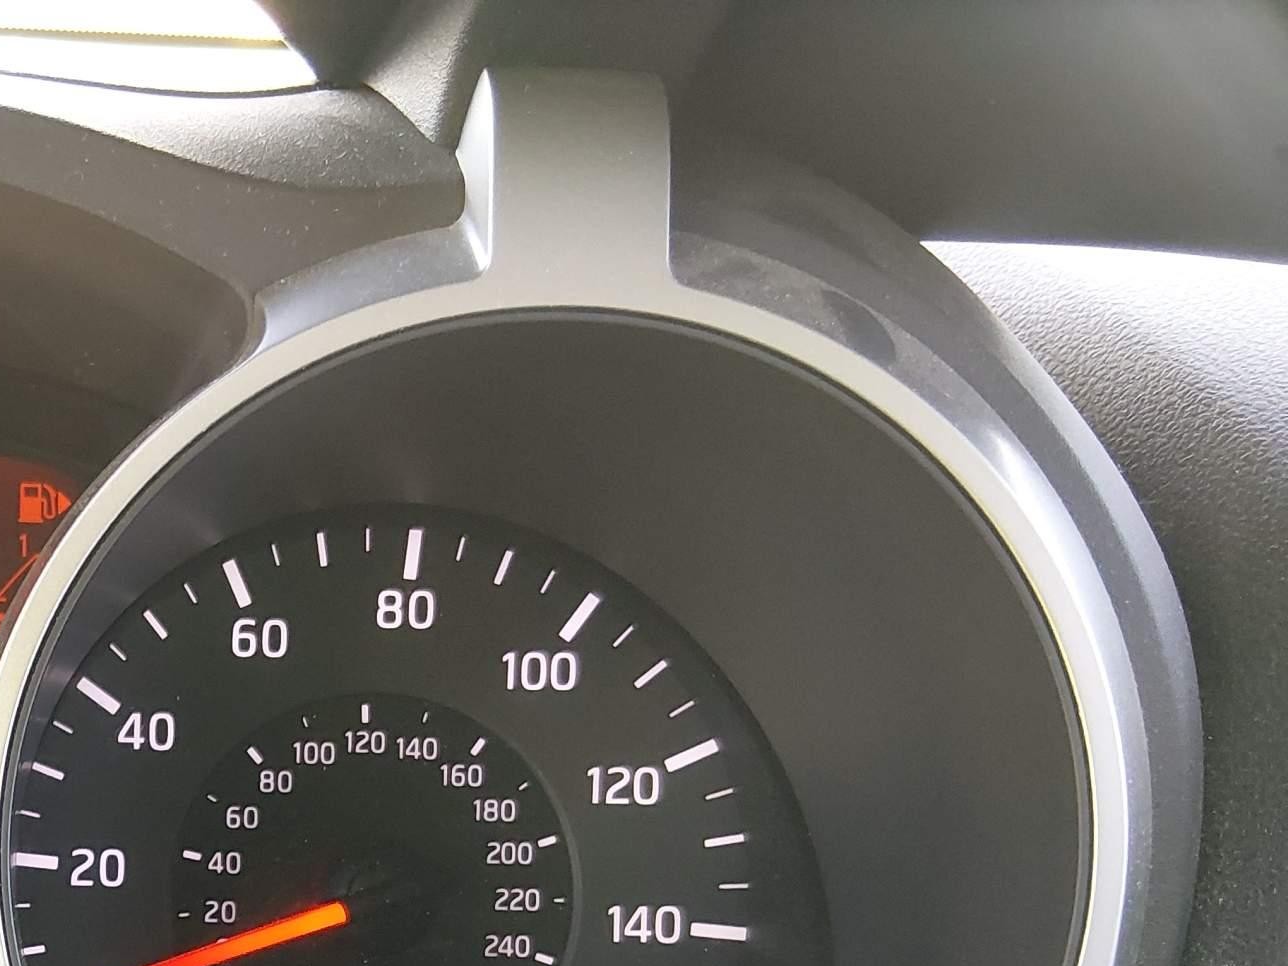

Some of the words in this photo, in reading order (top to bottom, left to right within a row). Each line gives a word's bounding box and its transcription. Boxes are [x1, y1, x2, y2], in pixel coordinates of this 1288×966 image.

[376, 590, 435, 629] 80
[231, 618, 289, 658] 60
[502, 651, 577, 691] 100
[117, 712, 175, 751] 40
[345, 731, 386, 754] 120
[293, 741, 335, 764] 100
[396, 738, 438, 760] 140
[259, 771, 292, 793] 80
[440, 765, 483, 787] 160
[587, 768, 660, 805] 120
[226, 806, 258, 829] 60
[473, 800, 516, 822] 180
[208, 852, 240, 874] 40
[486, 842, 533, 865] 200
[70, 849, 125, 887] 20
[494, 889, 540, 911] 220
[204, 901, 236, 923] 20
[607, 905, 681, 944] 140
[484, 935, 530, 957] 240
